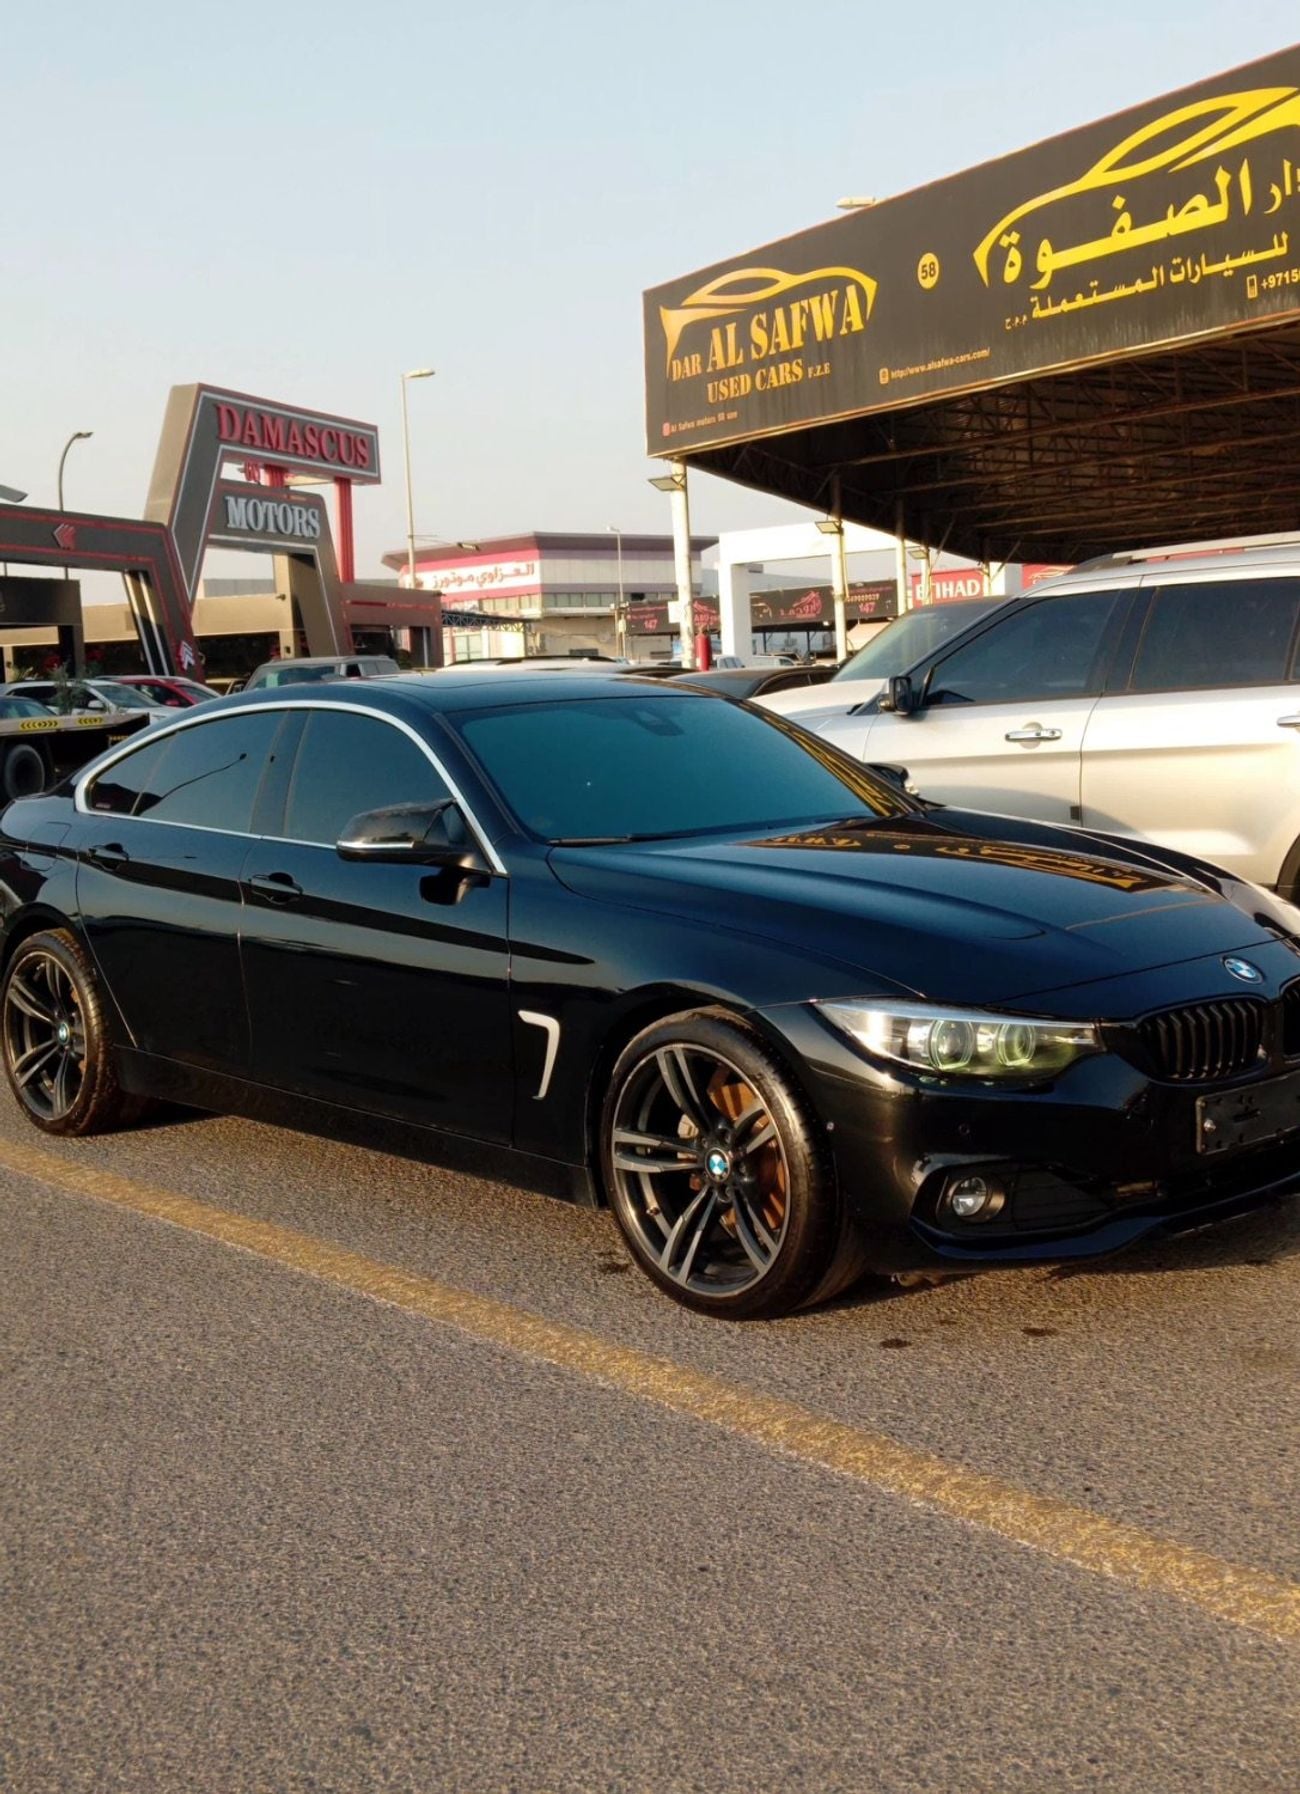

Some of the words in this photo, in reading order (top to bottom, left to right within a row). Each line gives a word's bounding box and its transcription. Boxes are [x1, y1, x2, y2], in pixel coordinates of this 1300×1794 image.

[1263, 158, 1300, 215] ار
[1000, 157, 1253, 291] الصفوة
[919, 260, 938, 281] 58
[1169, 231, 1289, 283] للسيارات
[1261, 268, 1300, 290] +9715
[1030, 266, 1165, 320] المستعملة
[672, 353, 702, 382] DAR
[706, 322, 744, 373] AL
[750, 284, 865, 360] SAFWA
[706, 374, 752, 404] USED
[755, 358, 804, 391] CARS
[216, 402, 371, 469] DAMASCUS
[225, 495, 322, 539] MOTORS
[915, 579, 981, 600] EIHAD
